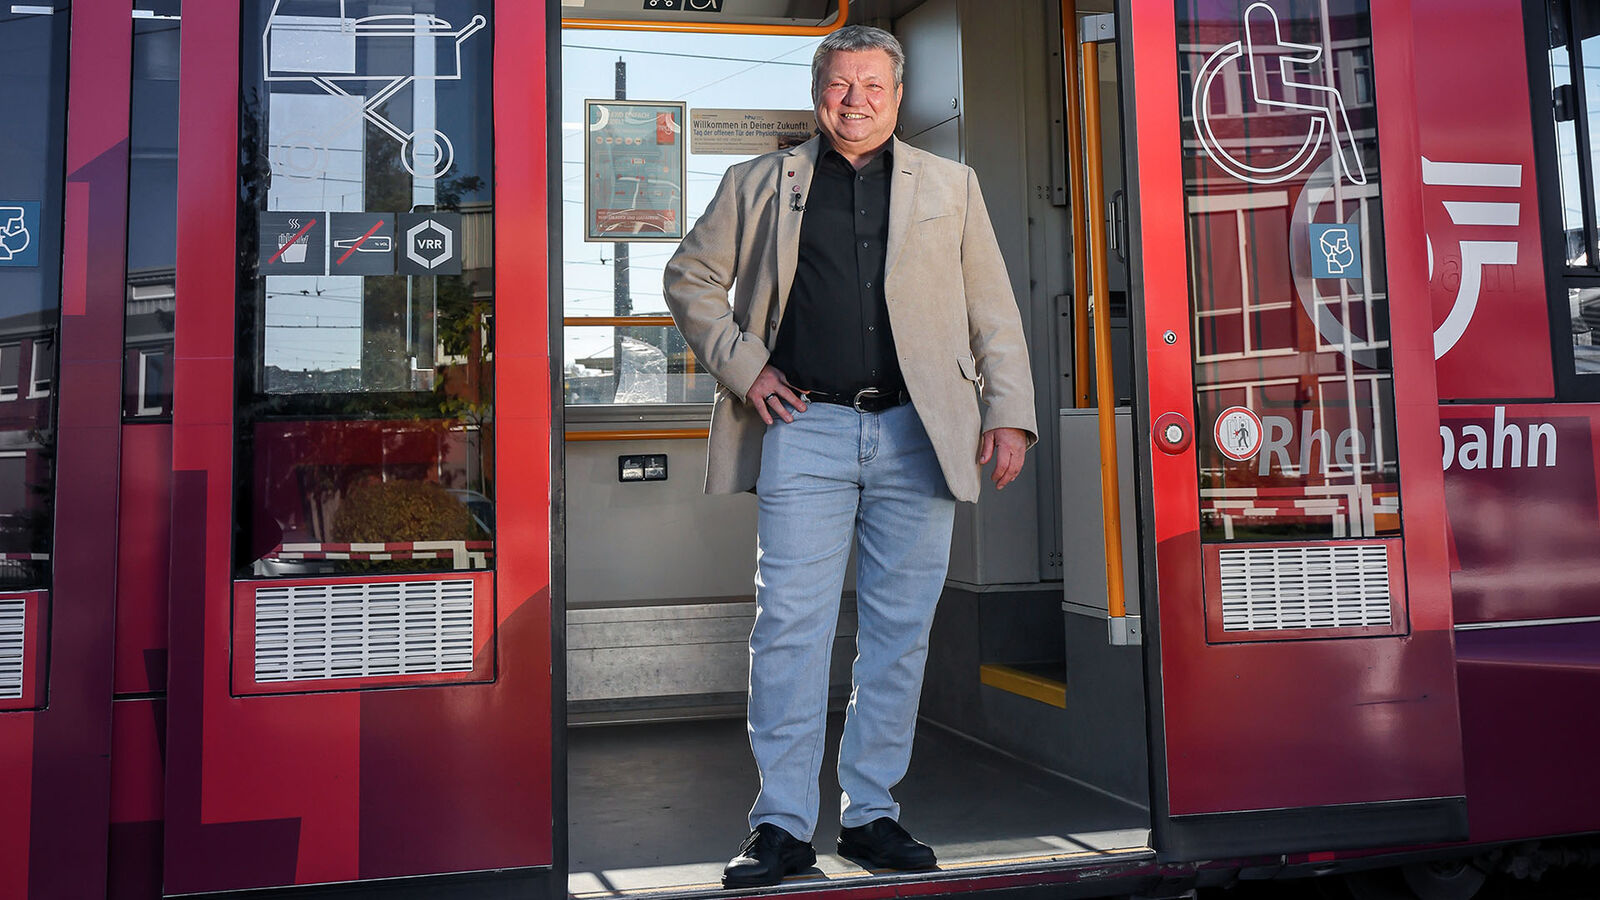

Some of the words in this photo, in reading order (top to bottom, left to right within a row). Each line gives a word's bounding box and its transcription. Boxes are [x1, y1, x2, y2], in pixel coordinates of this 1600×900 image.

[693, 120, 739, 129] Willkommen
[741, 121, 748, 129] in
[750, 121, 774, 129] Deiner
[776, 121, 808, 130] Zukunft!
[693, 129, 703, 137] Tag
[417, 239, 442, 249] VRR
